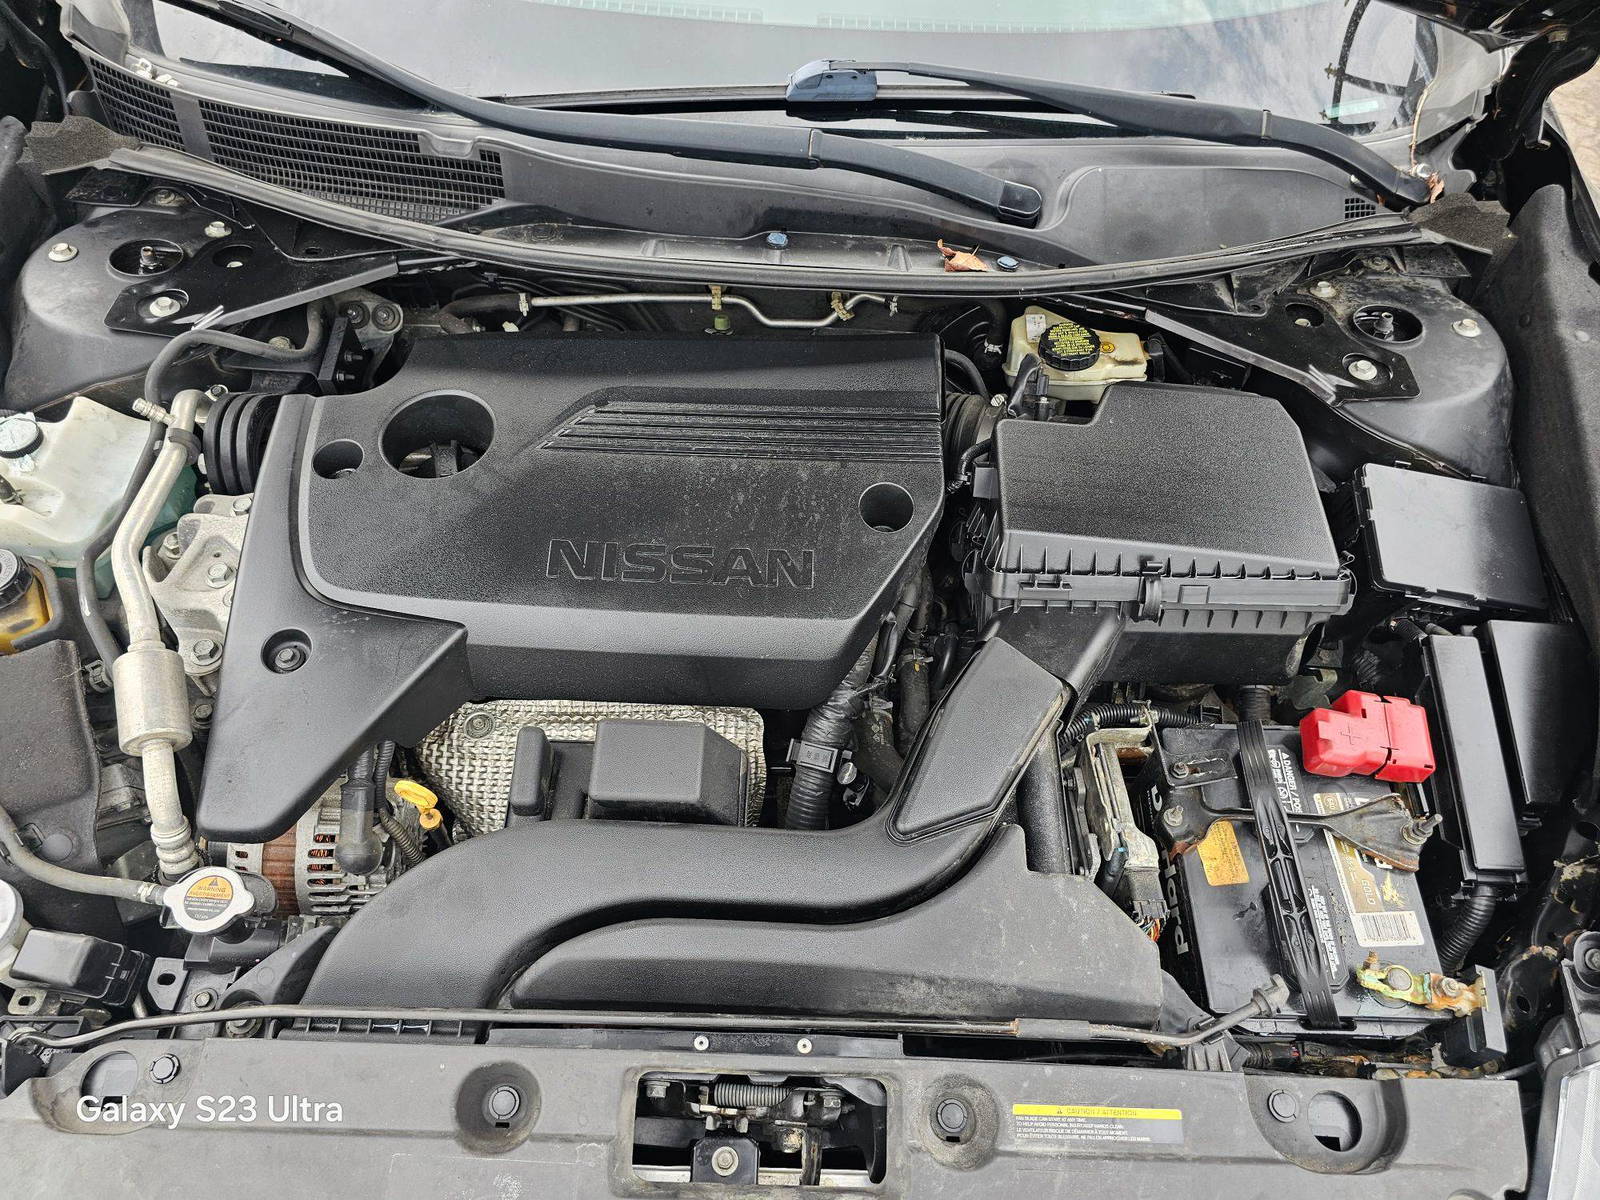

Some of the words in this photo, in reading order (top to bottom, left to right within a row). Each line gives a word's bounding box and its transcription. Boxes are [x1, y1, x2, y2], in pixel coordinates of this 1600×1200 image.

[546, 538, 815, 590] NISSAN
[1283, 760, 1298, 790] DANGER
[1361, 879, 1376, 905] GOLD
